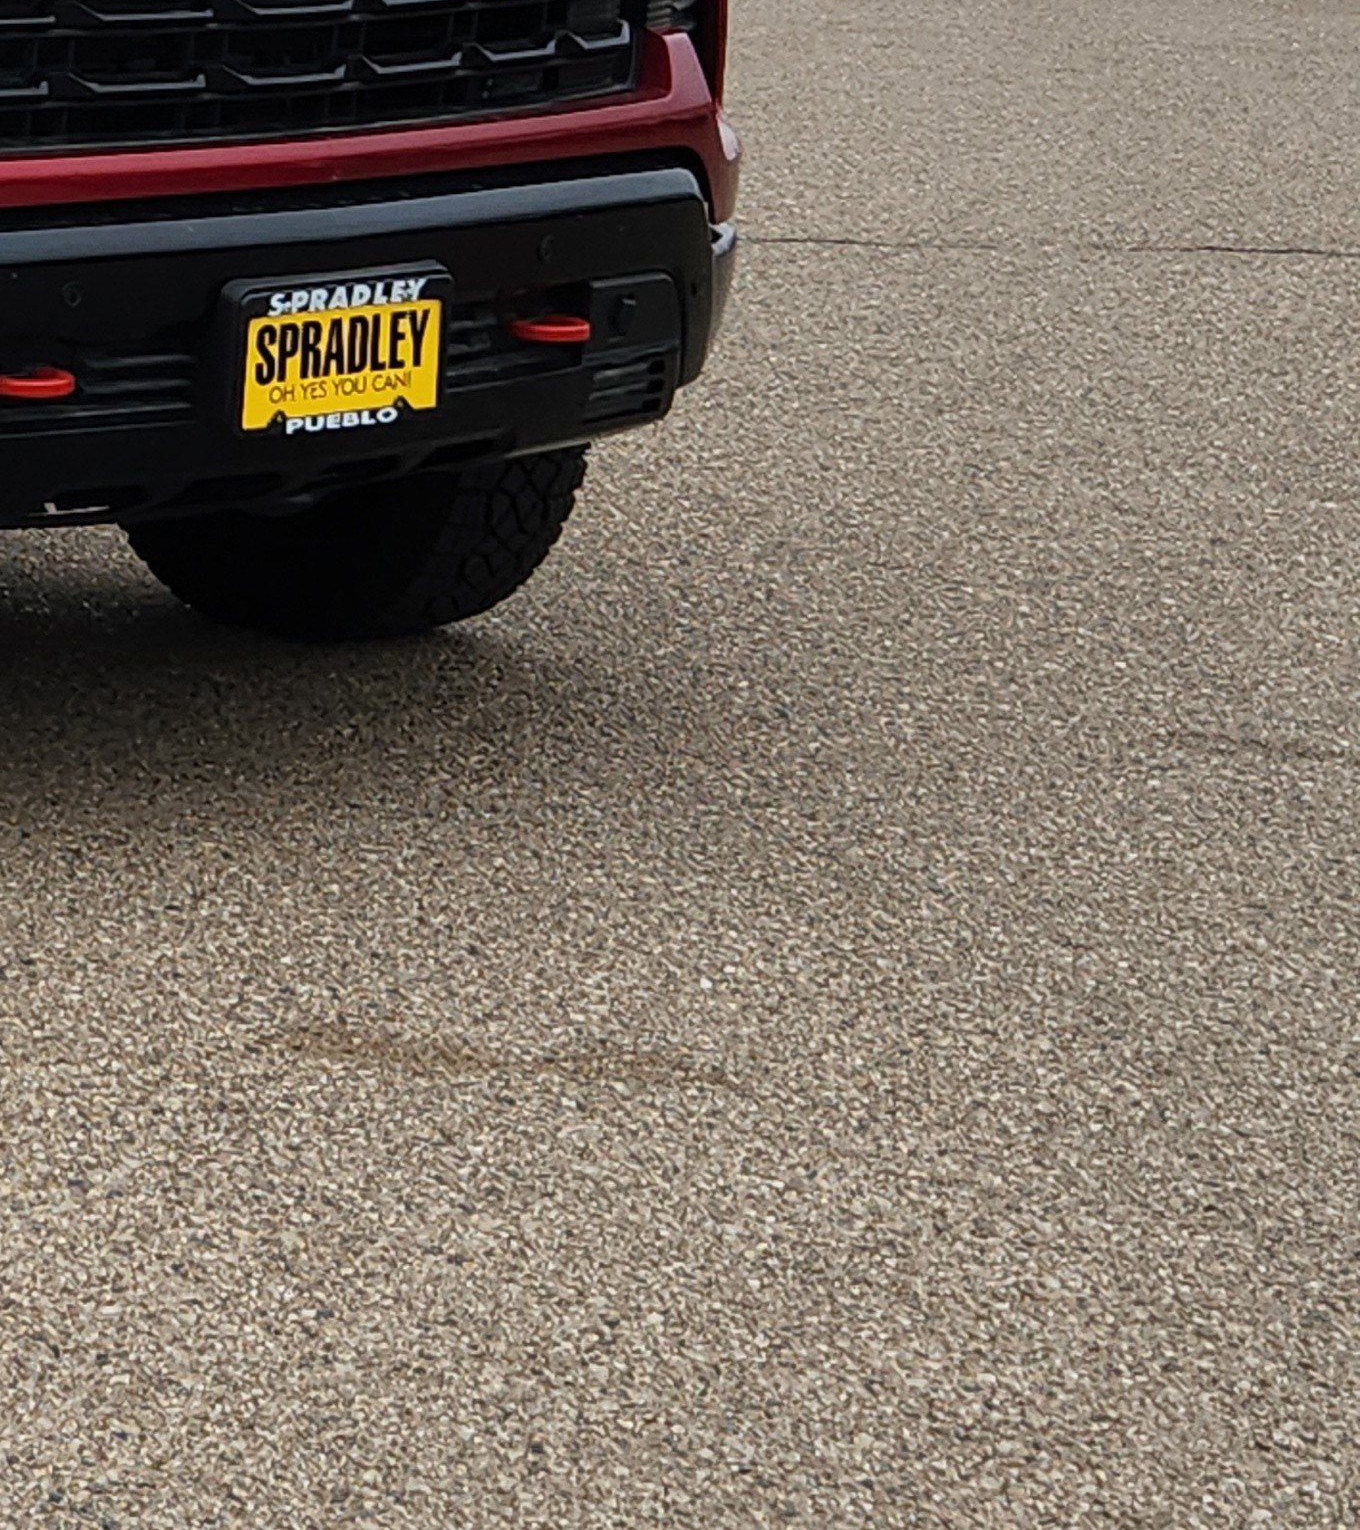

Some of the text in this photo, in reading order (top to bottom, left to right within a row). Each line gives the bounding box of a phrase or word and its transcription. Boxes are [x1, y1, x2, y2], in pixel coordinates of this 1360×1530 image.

[267, 277, 429, 317] SPRADLEY
[254, 308, 431, 386] SPRADLEY
[268, 385, 295, 404] OH
[300, 381, 328, 400] YES
[332, 377, 368, 397] YOU
[285, 406, 398, 435] PUEBLO
